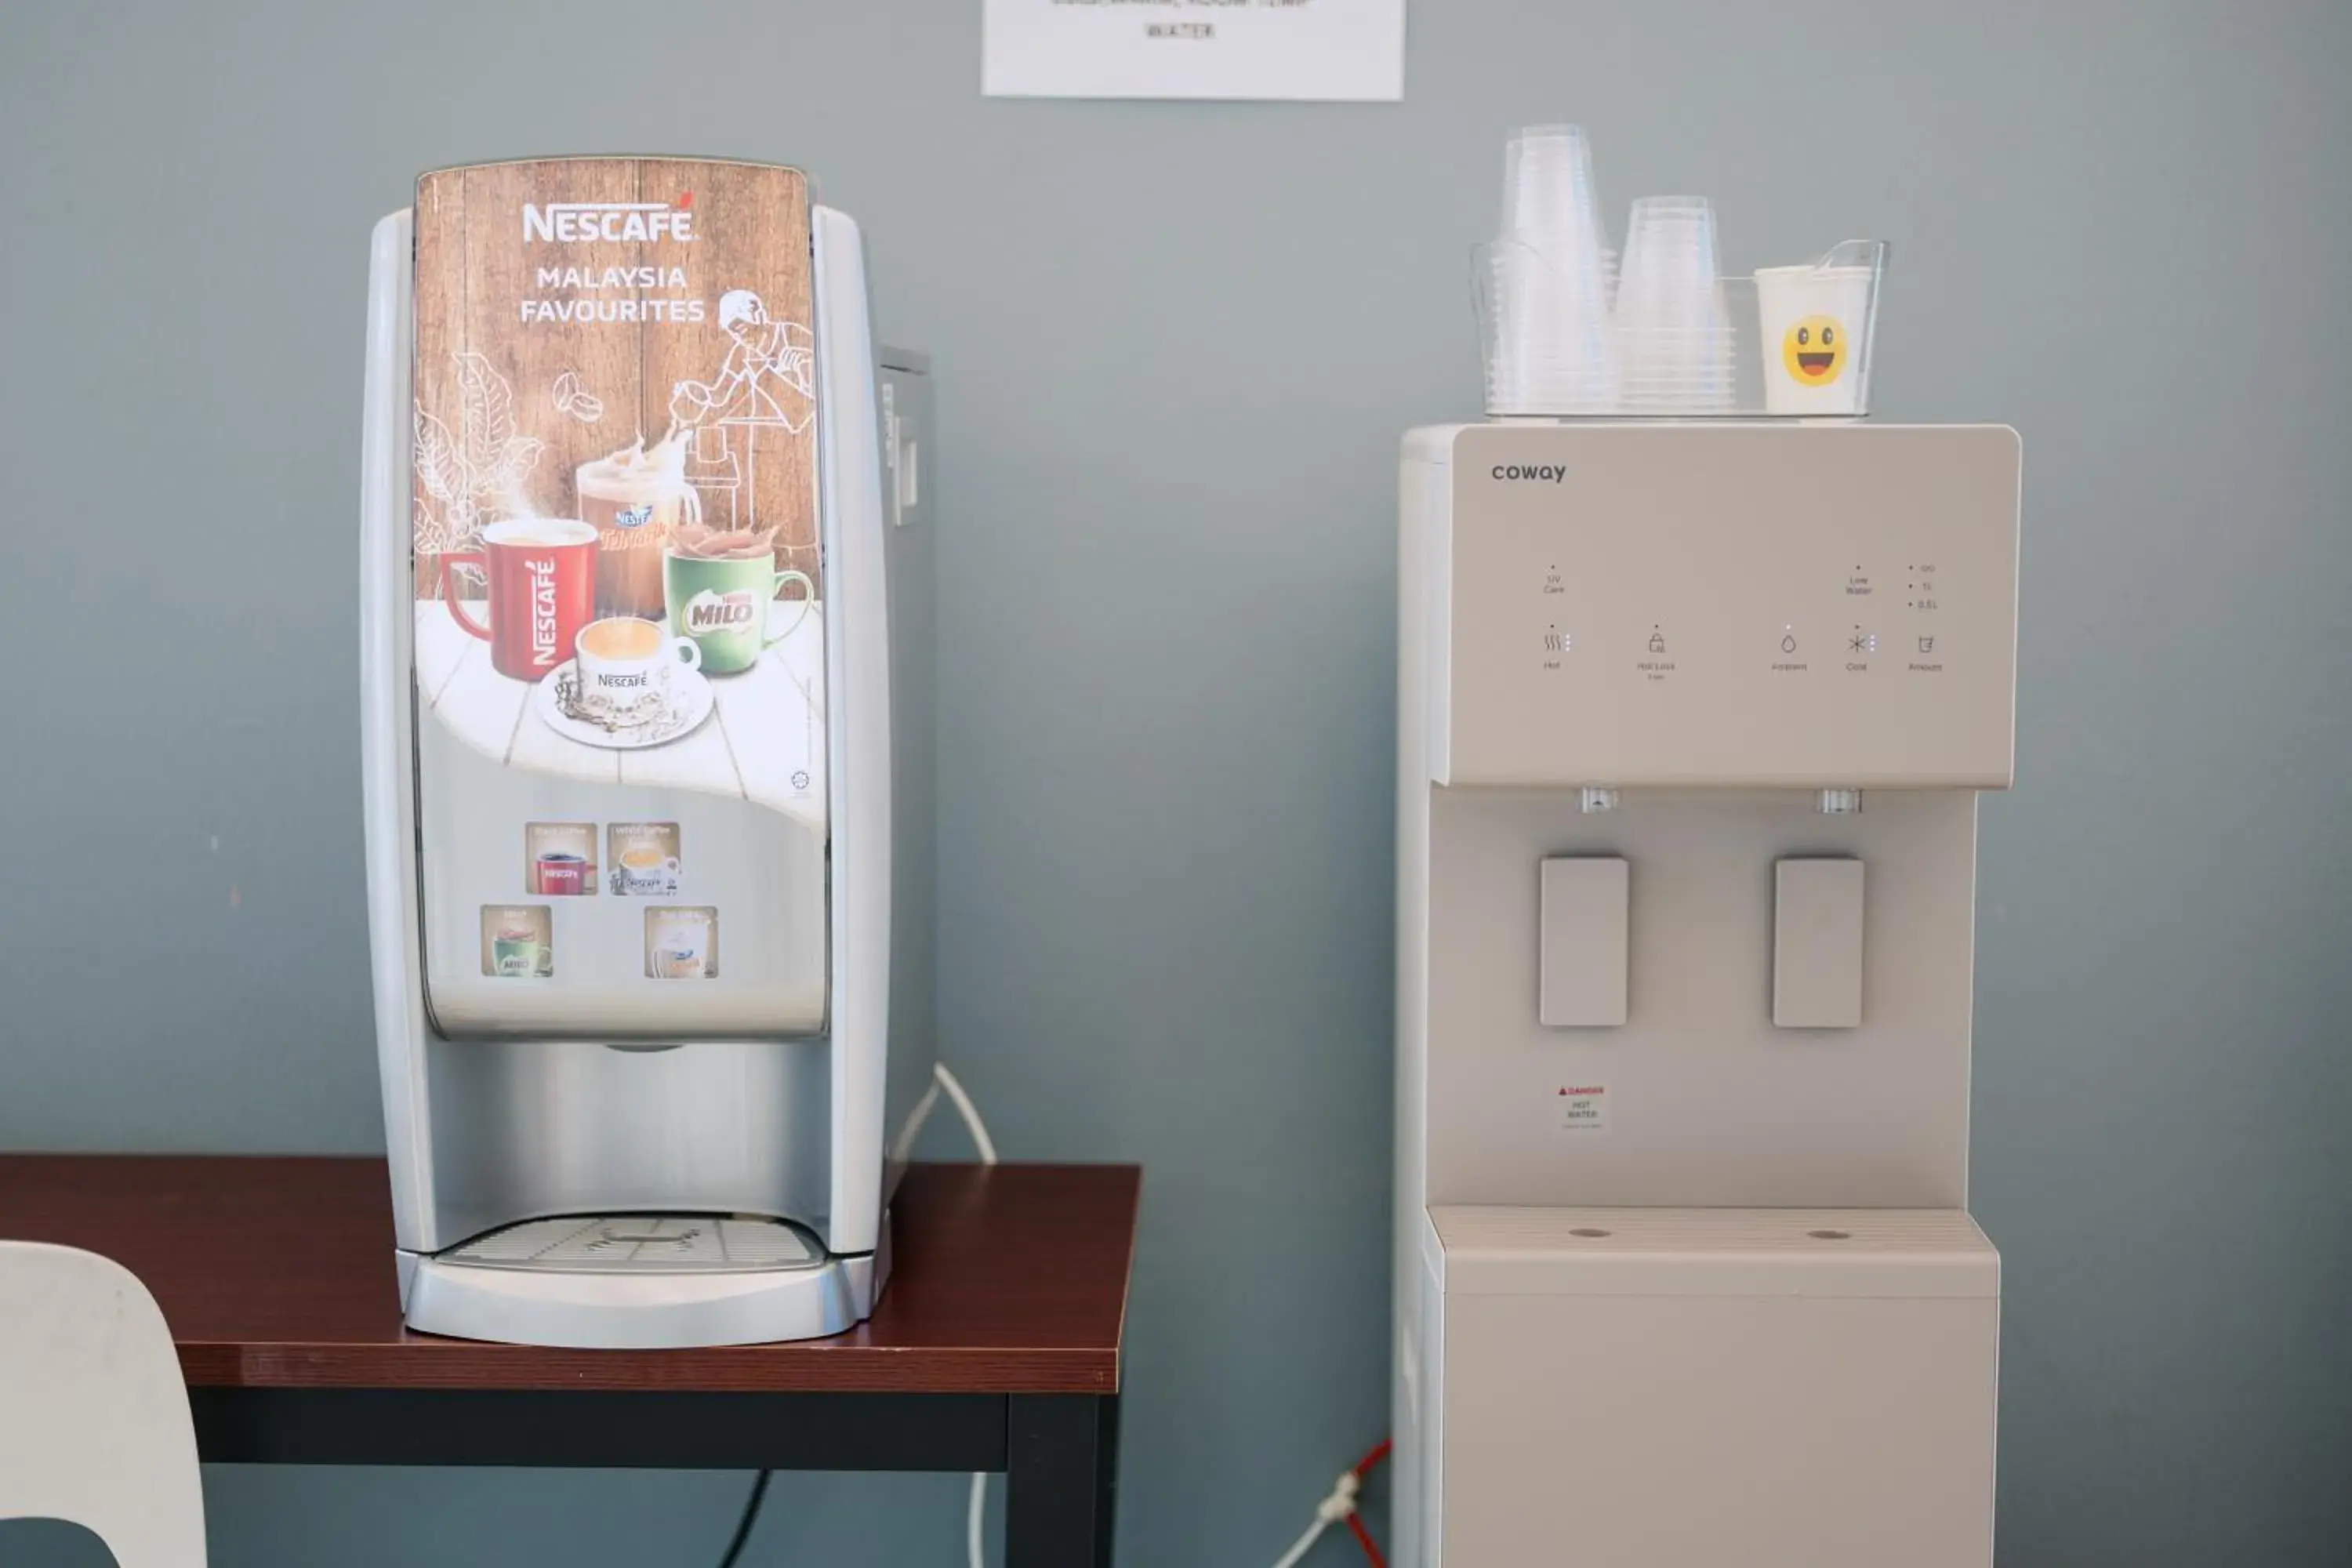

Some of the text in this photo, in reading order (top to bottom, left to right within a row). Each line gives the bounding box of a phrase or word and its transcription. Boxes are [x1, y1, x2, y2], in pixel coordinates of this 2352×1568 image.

[537, 267, 688, 289] MALAYSIA
[521, 299, 705, 323] FAVOURITES
[1492, 465, 1566, 484] coway
[524, 557, 557, 666] NESCAFÉ
[691, 604, 753, 626] MILO
